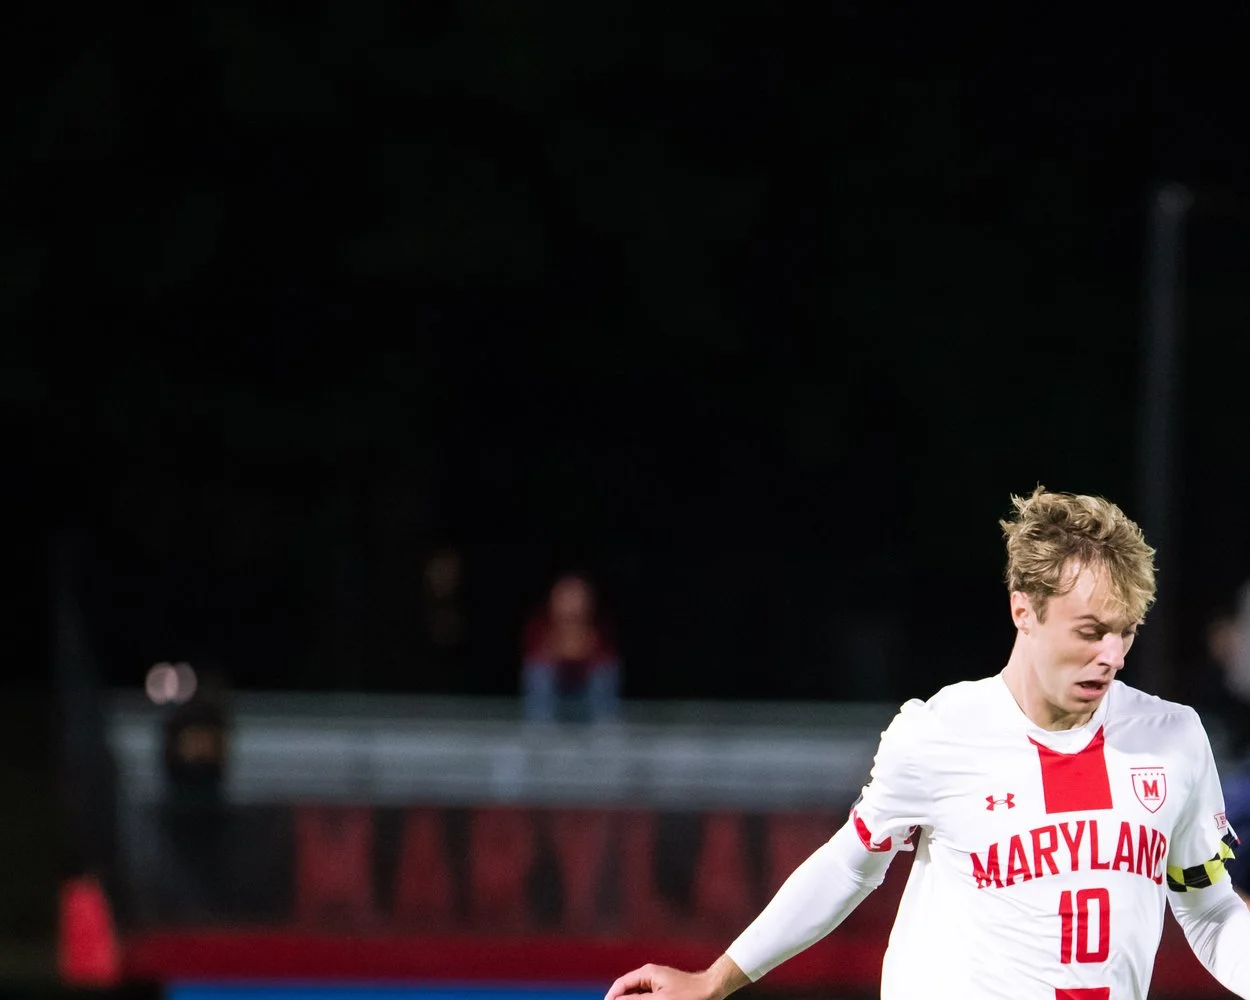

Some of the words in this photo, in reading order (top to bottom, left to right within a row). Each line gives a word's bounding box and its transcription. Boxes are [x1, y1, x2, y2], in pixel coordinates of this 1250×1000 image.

[1142, 779, 1160, 798] M
[970, 820, 1167, 889] MARYLAND
[1058, 888, 1111, 964] 10
